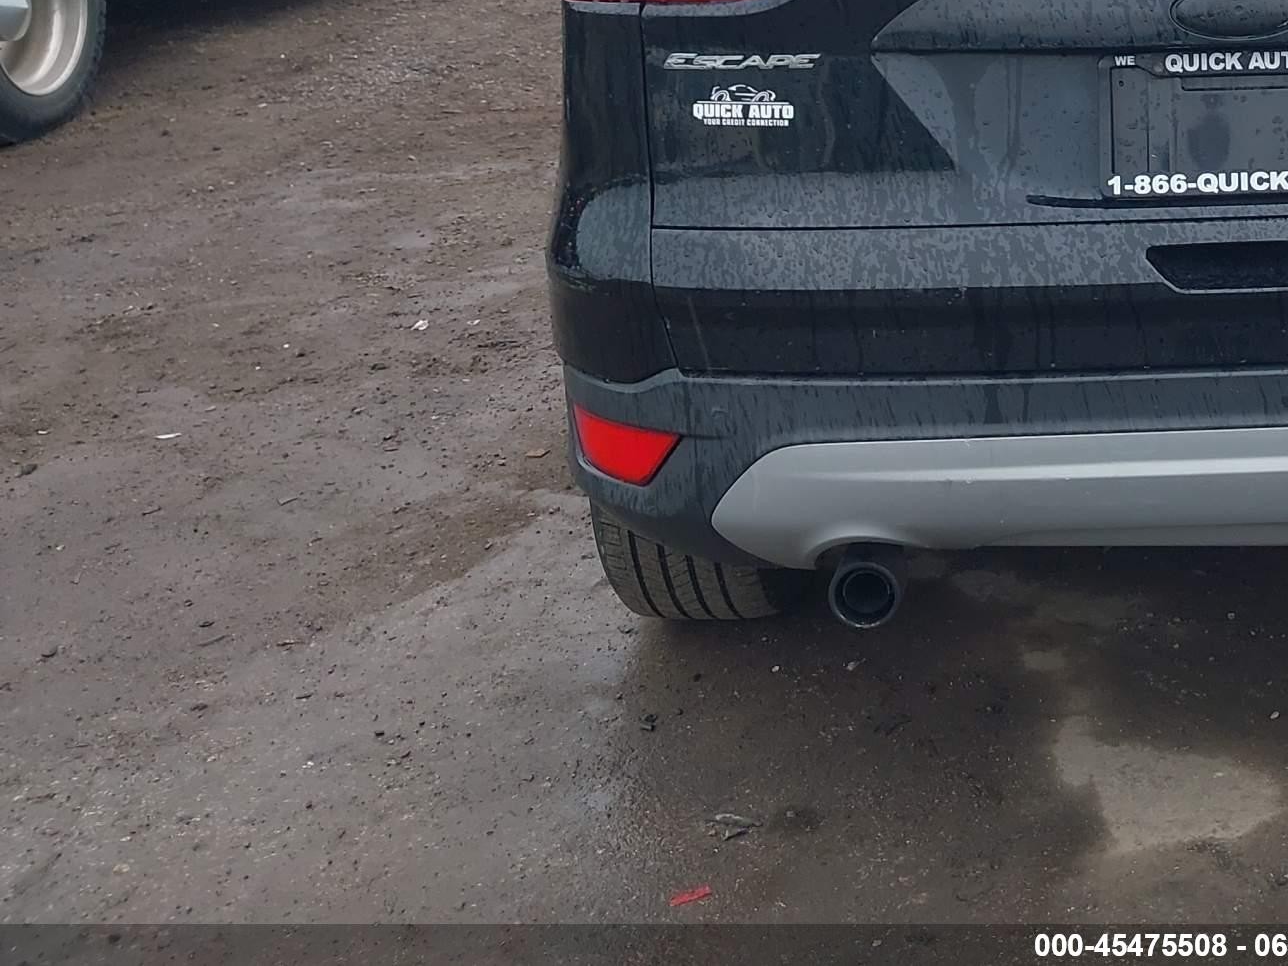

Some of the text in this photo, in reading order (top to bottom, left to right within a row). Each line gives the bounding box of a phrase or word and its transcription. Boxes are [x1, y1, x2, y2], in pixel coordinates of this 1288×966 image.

[664, 53, 821, 70] ESCAPE
[1114, 55, 1136, 66] WE
[1165, 52, 1243, 73] QUICK
[693, 103, 795, 120] QUICK AUTO
